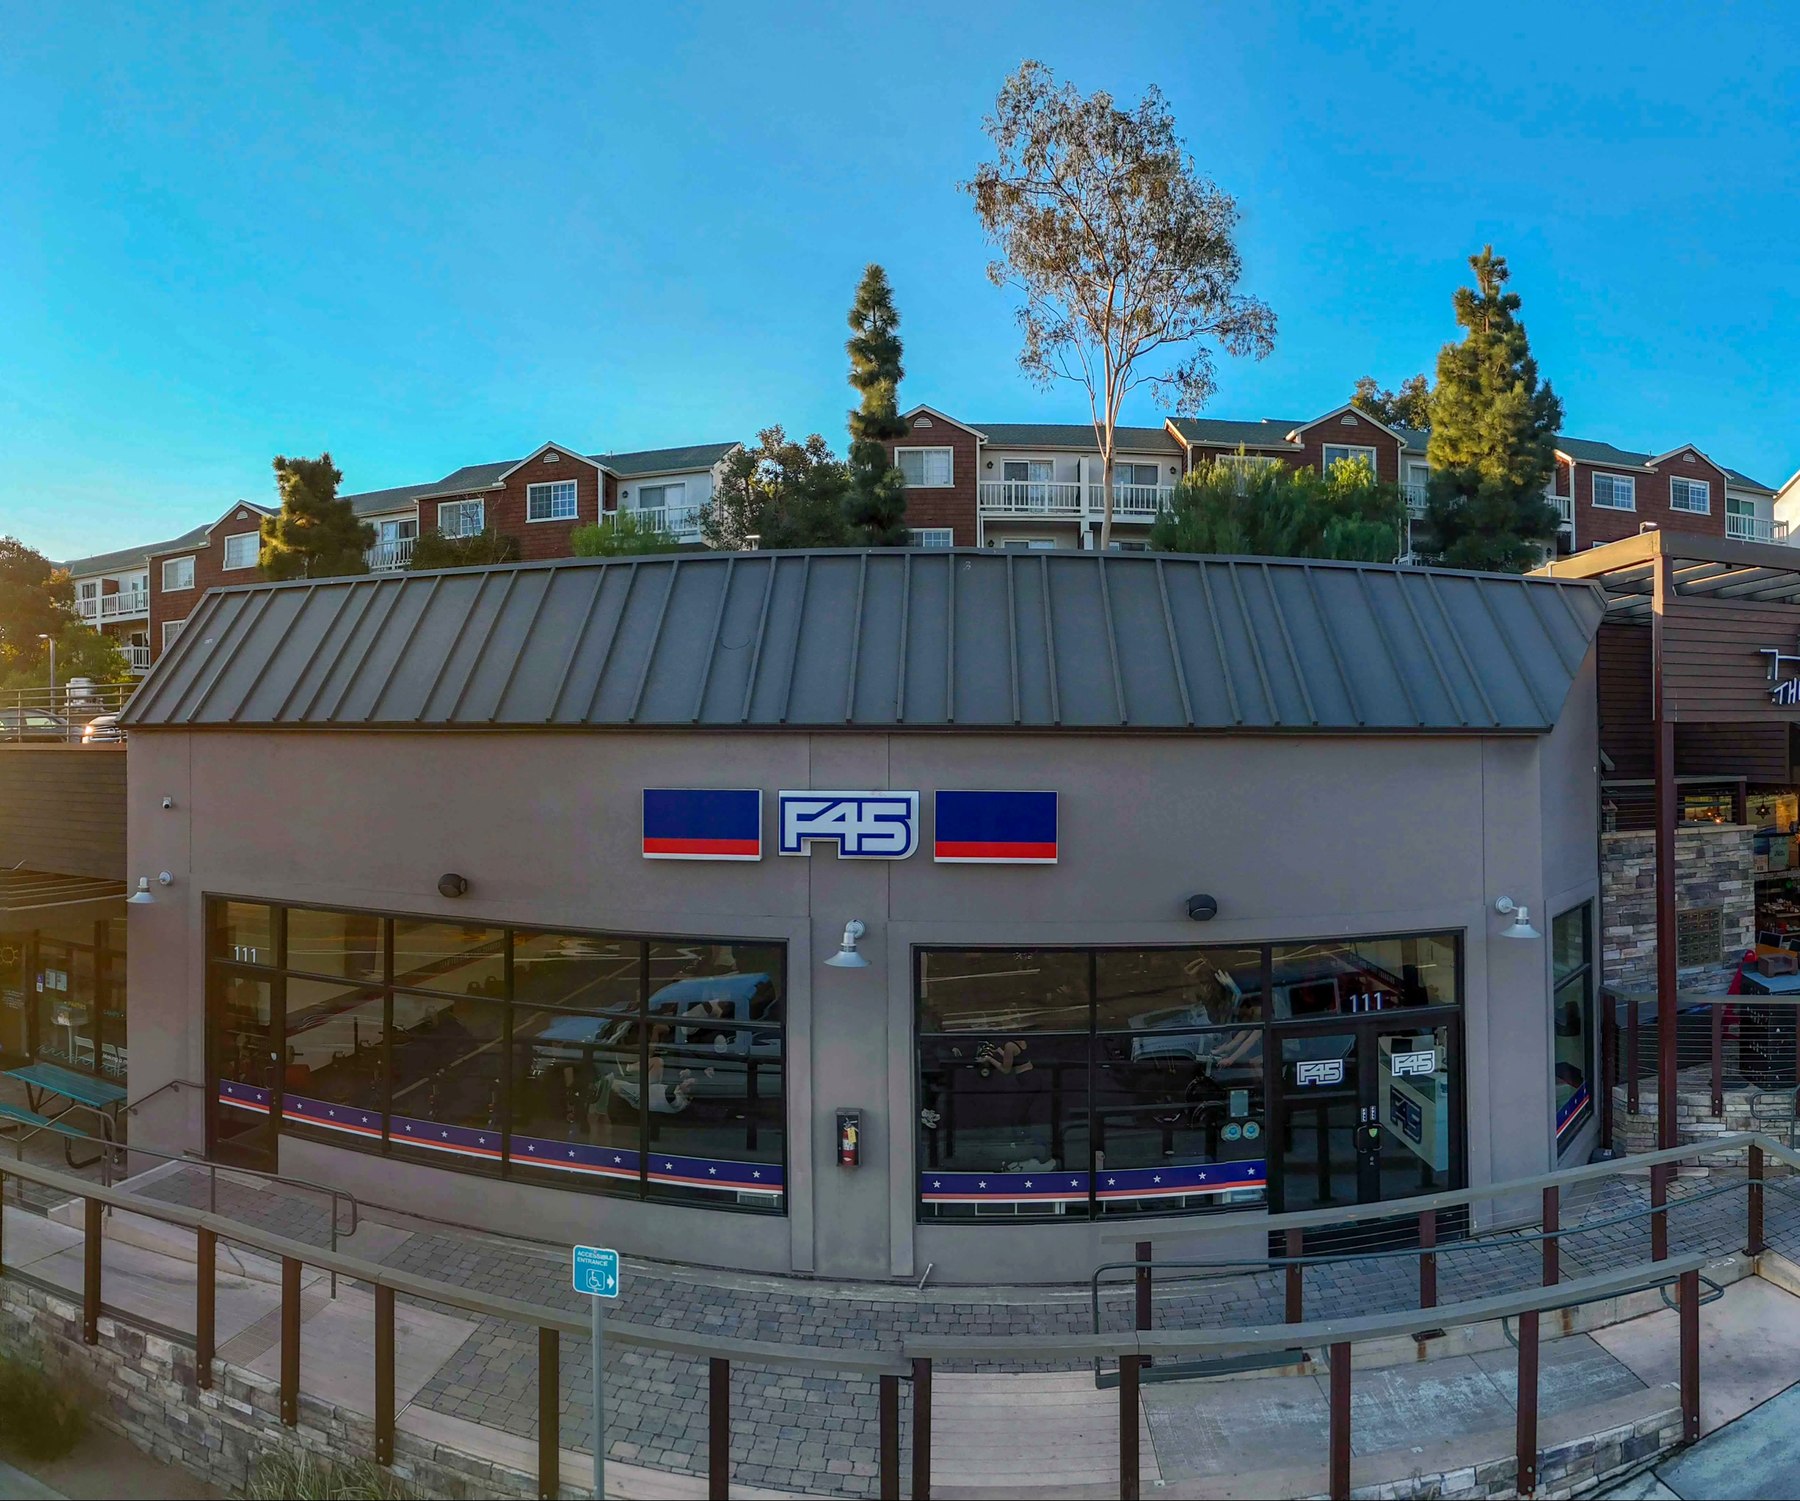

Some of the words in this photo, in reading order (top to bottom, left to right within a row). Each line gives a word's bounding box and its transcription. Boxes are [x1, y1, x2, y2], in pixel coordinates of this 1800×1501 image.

[1773, 677, 1800, 705] TH
[779, 796, 913, 857] F45
[234, 946, 257, 963] 111
[1350, 991, 1383, 1013] 111
[1297, 1059, 1343, 1085] F45
[1392, 1051, 1435, 1076] F45
[577, 1250, 613, 1260] ACCESSIBLE
[577, 1257, 608, 1266] ENTRANCE
